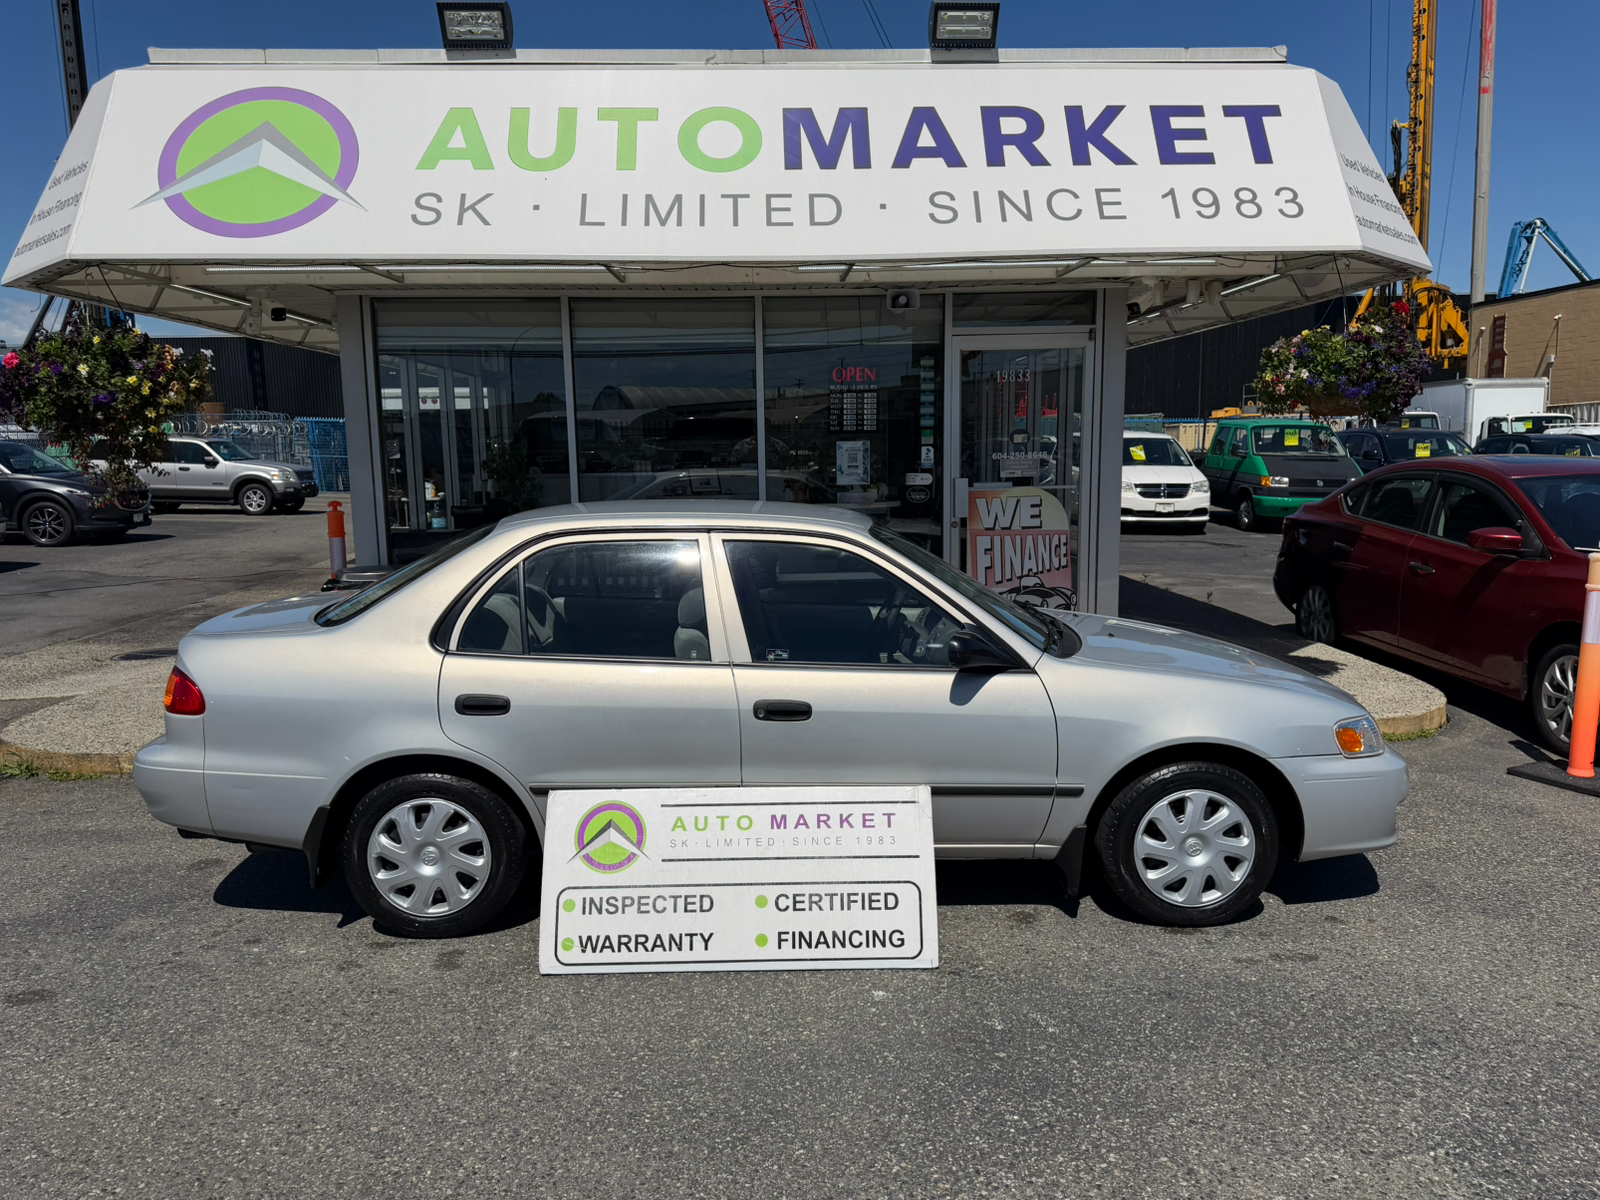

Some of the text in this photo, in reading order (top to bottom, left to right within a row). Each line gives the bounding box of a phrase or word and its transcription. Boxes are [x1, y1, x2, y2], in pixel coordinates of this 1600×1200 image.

[1356, 159, 1385, 183] Vehicles
[410, 186, 1305, 227] SK LIMITED SINCE 1983
[832, 366, 876, 382] OPEN
[996, 369, 1031, 383] 19833
[992, 451, 1048, 460] 604-250-8646
[975, 495, 1042, 530] WE
[975, 533, 1068, 586] FINANCE
[670, 812, 897, 832] AUTO MARKET
[669, 835, 897, 849] SK LIMITED SINCE 1983
[581, 891, 900, 915] INSPECTED CERTIFIED
[578, 929, 906, 953] WARRANTY FINANCING
